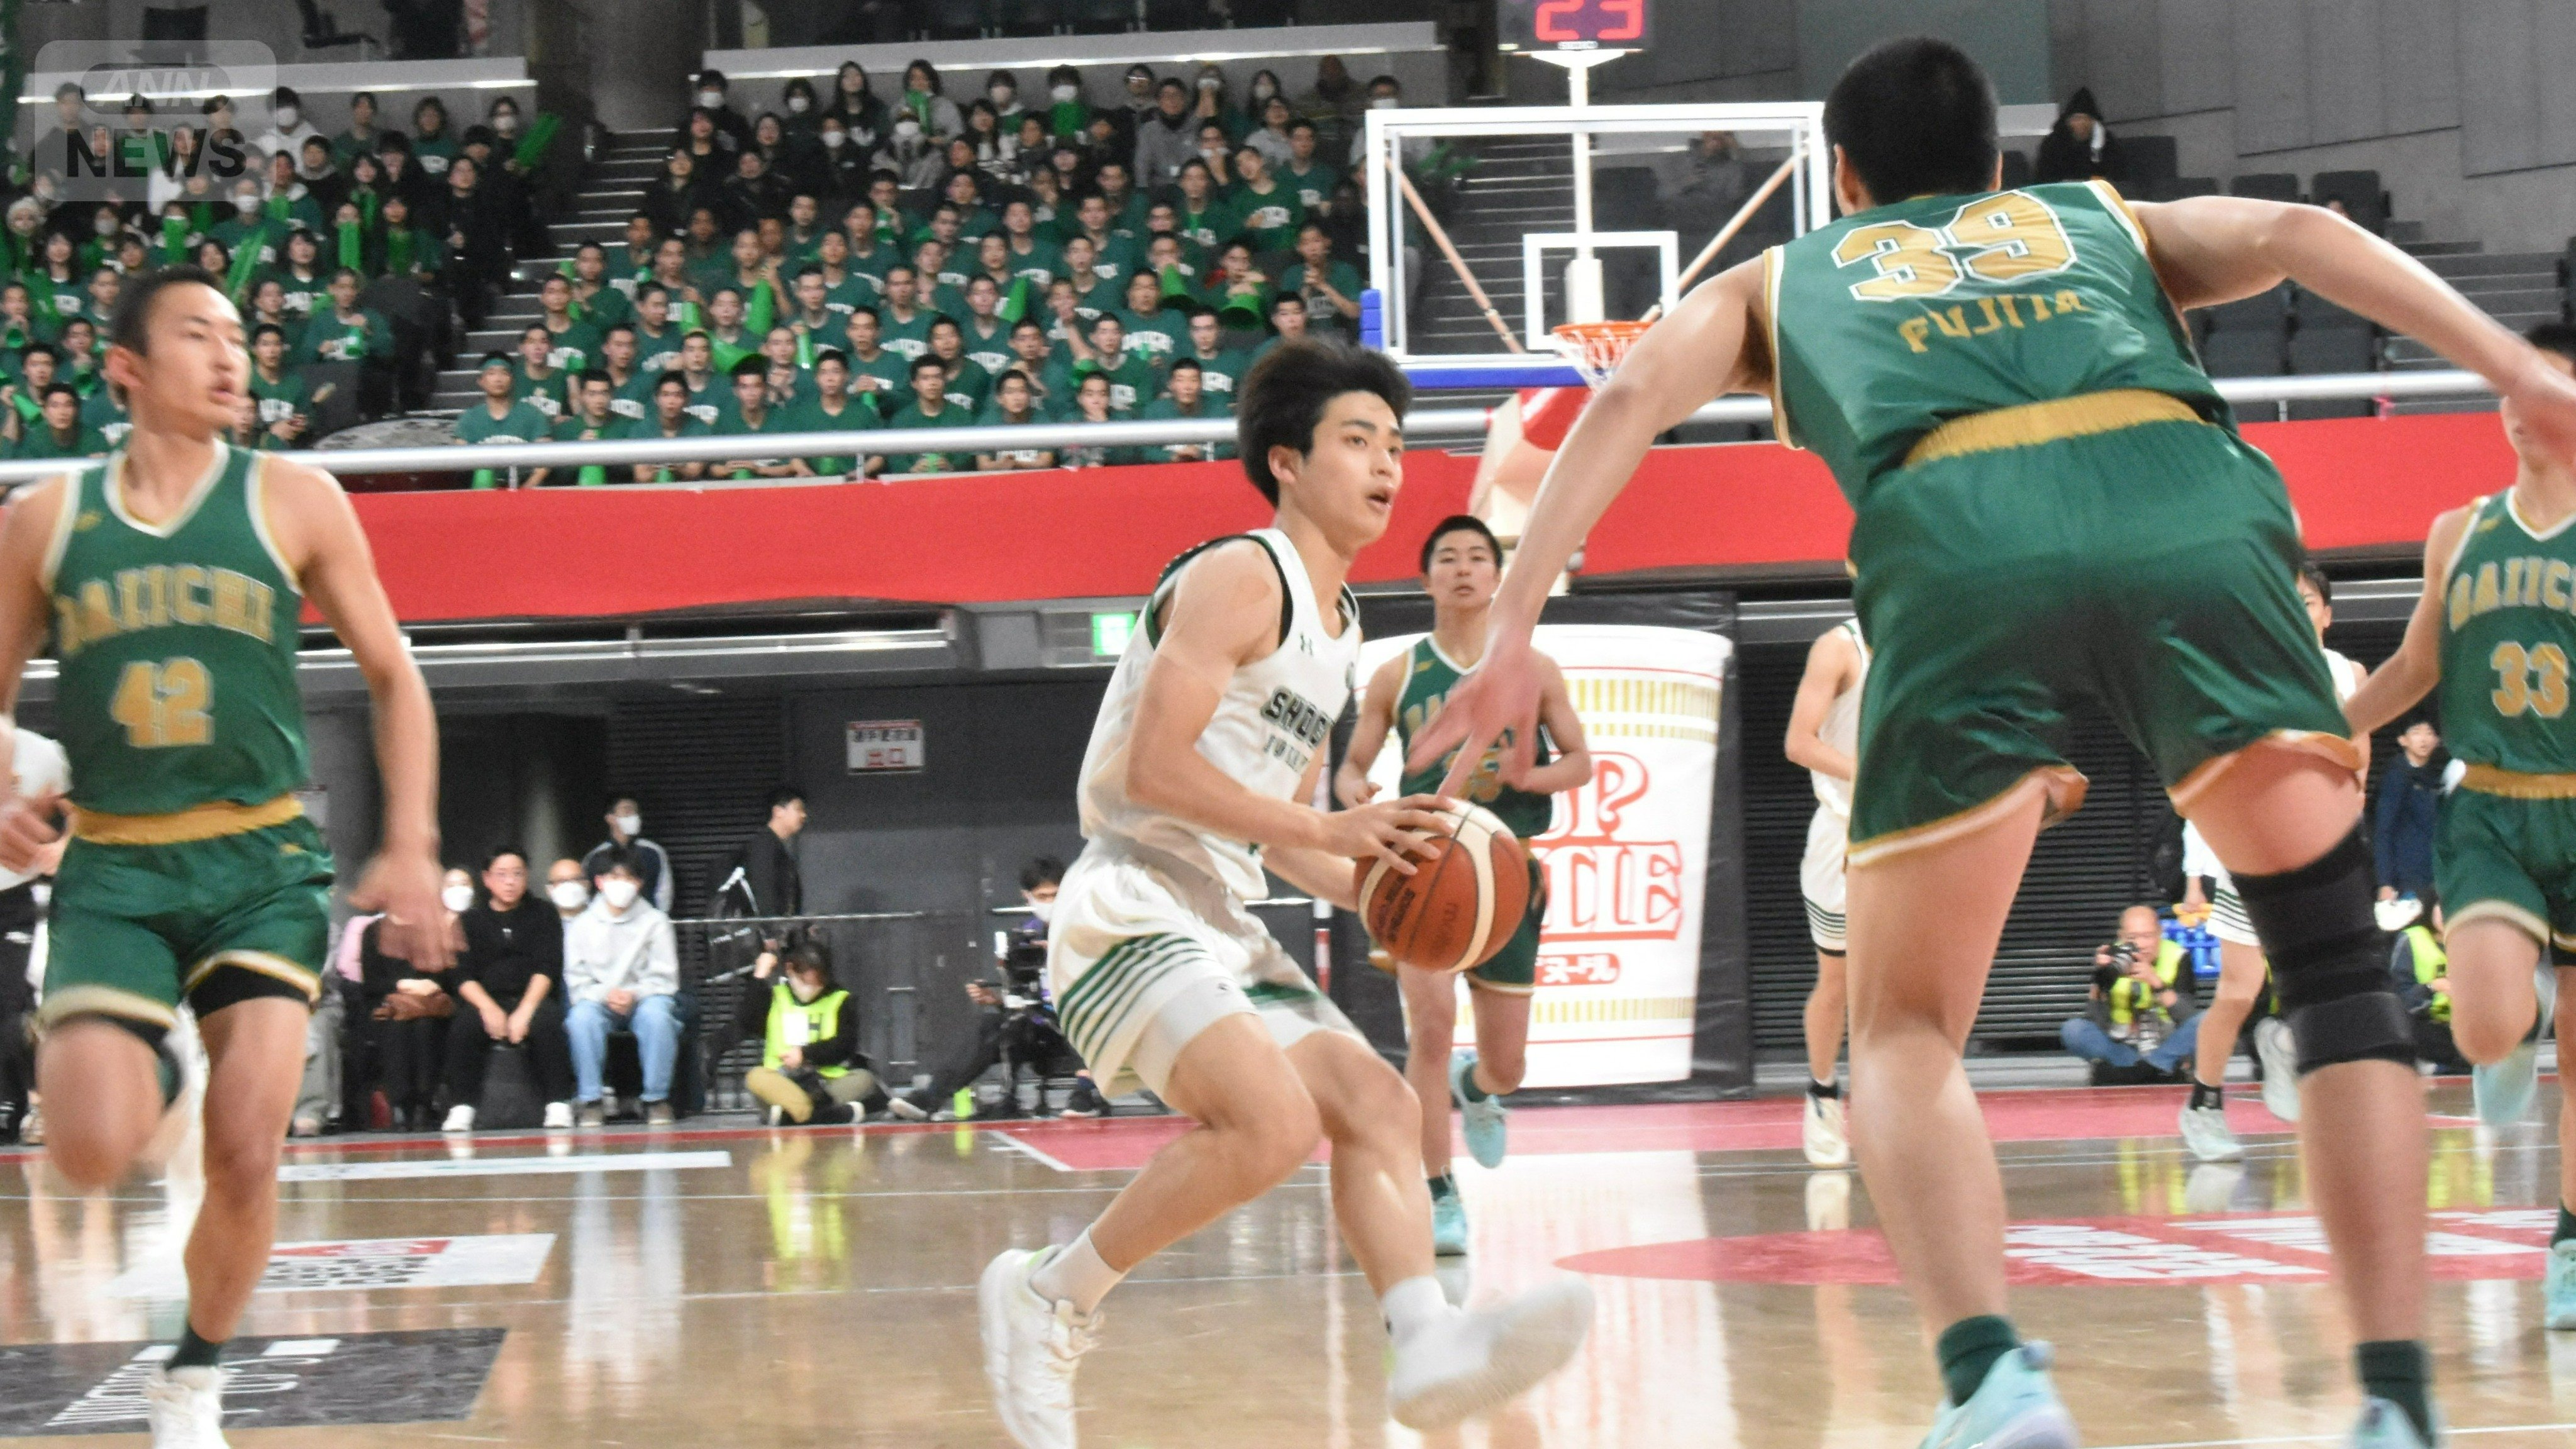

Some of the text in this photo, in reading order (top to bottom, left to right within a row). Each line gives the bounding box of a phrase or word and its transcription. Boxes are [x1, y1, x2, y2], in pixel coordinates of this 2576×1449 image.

[1831, 189, 2078, 302] 39
[108, 656, 215, 748] 42
[2490, 640, 2570, 718] 33
